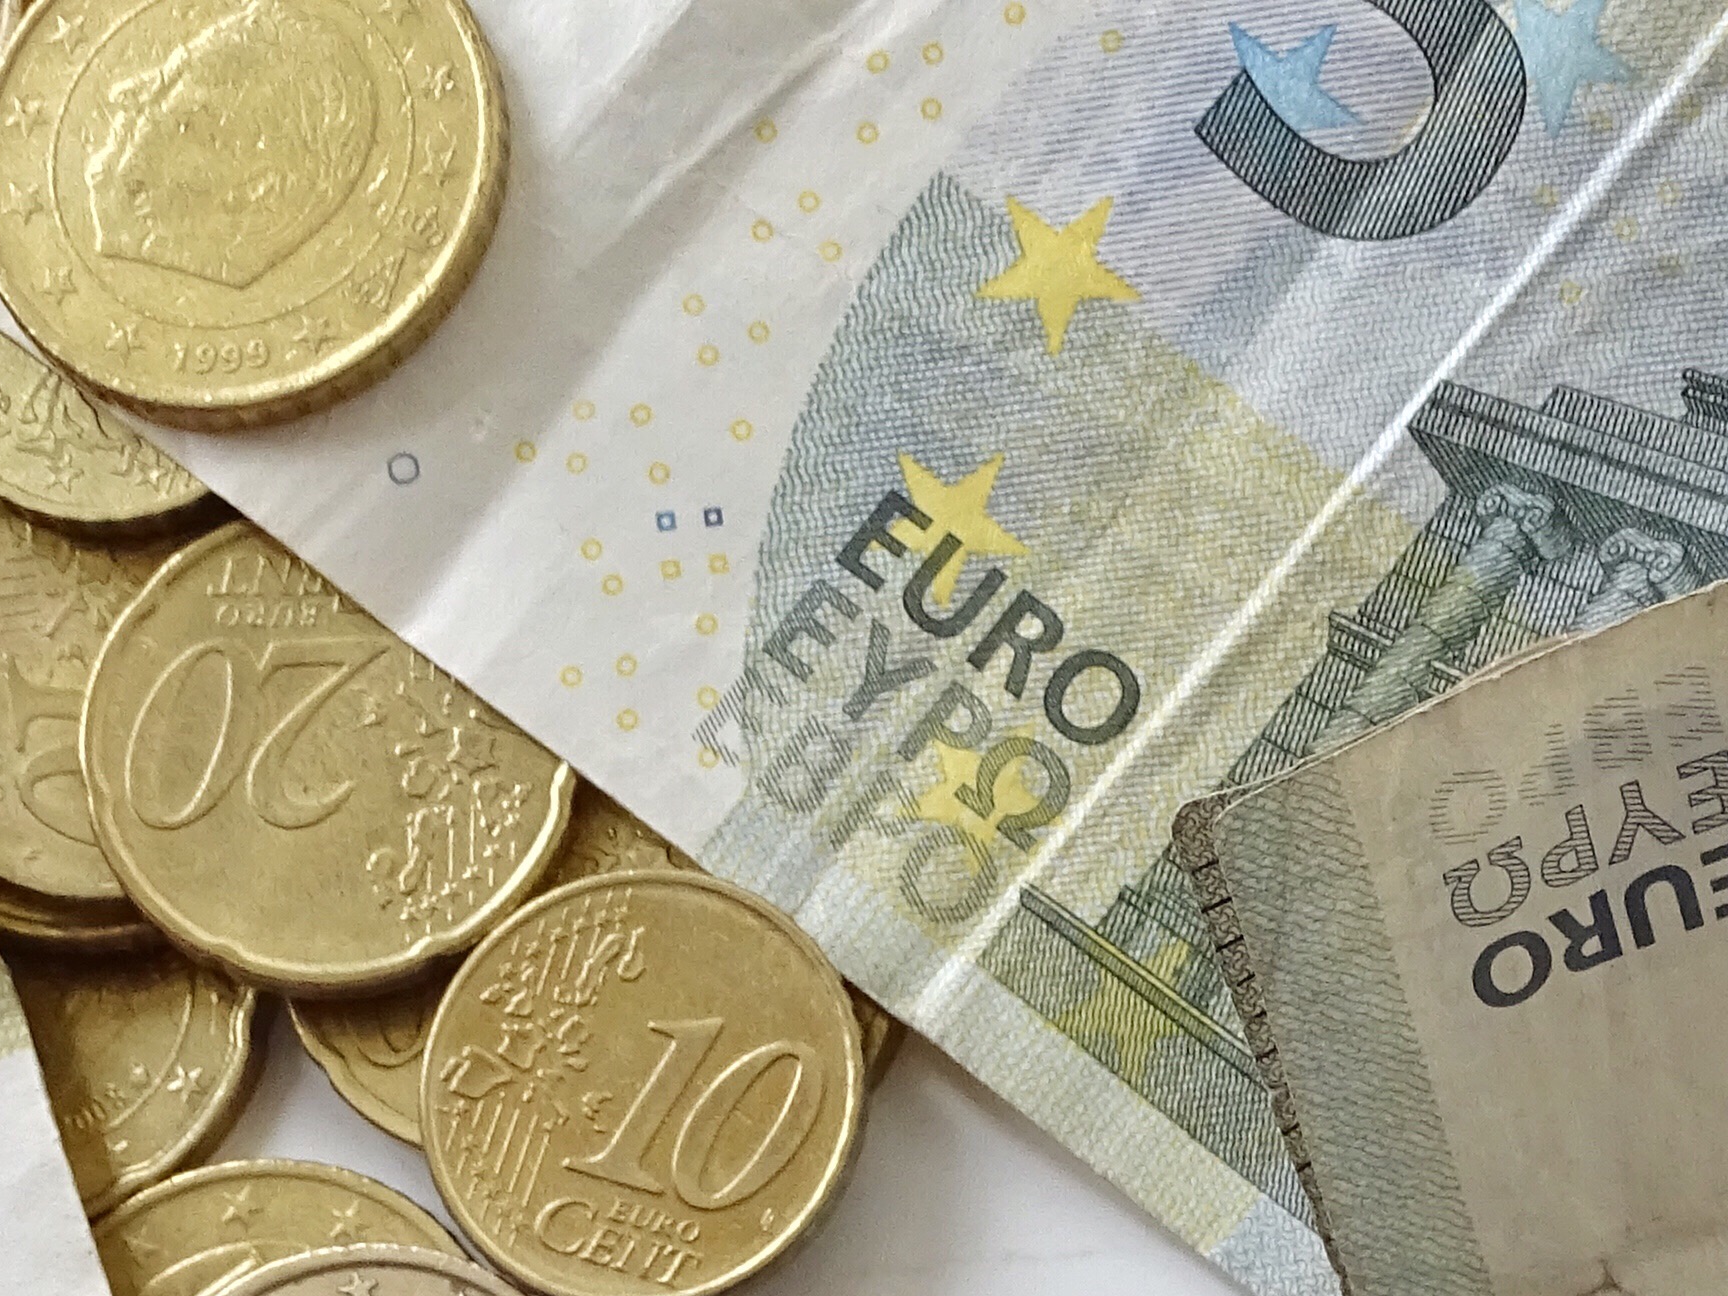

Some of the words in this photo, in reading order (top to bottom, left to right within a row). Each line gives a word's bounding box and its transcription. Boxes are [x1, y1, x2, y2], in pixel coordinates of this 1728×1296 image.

[173, 338, 271, 374] 1999
[836, 491, 1141, 747] EURO
[125, 634, 392, 832] 20
[562, 1014, 814, 1212] 10
[534, 1202, 702, 1284] CENT
[610, 1198, 702, 1245] EURO
